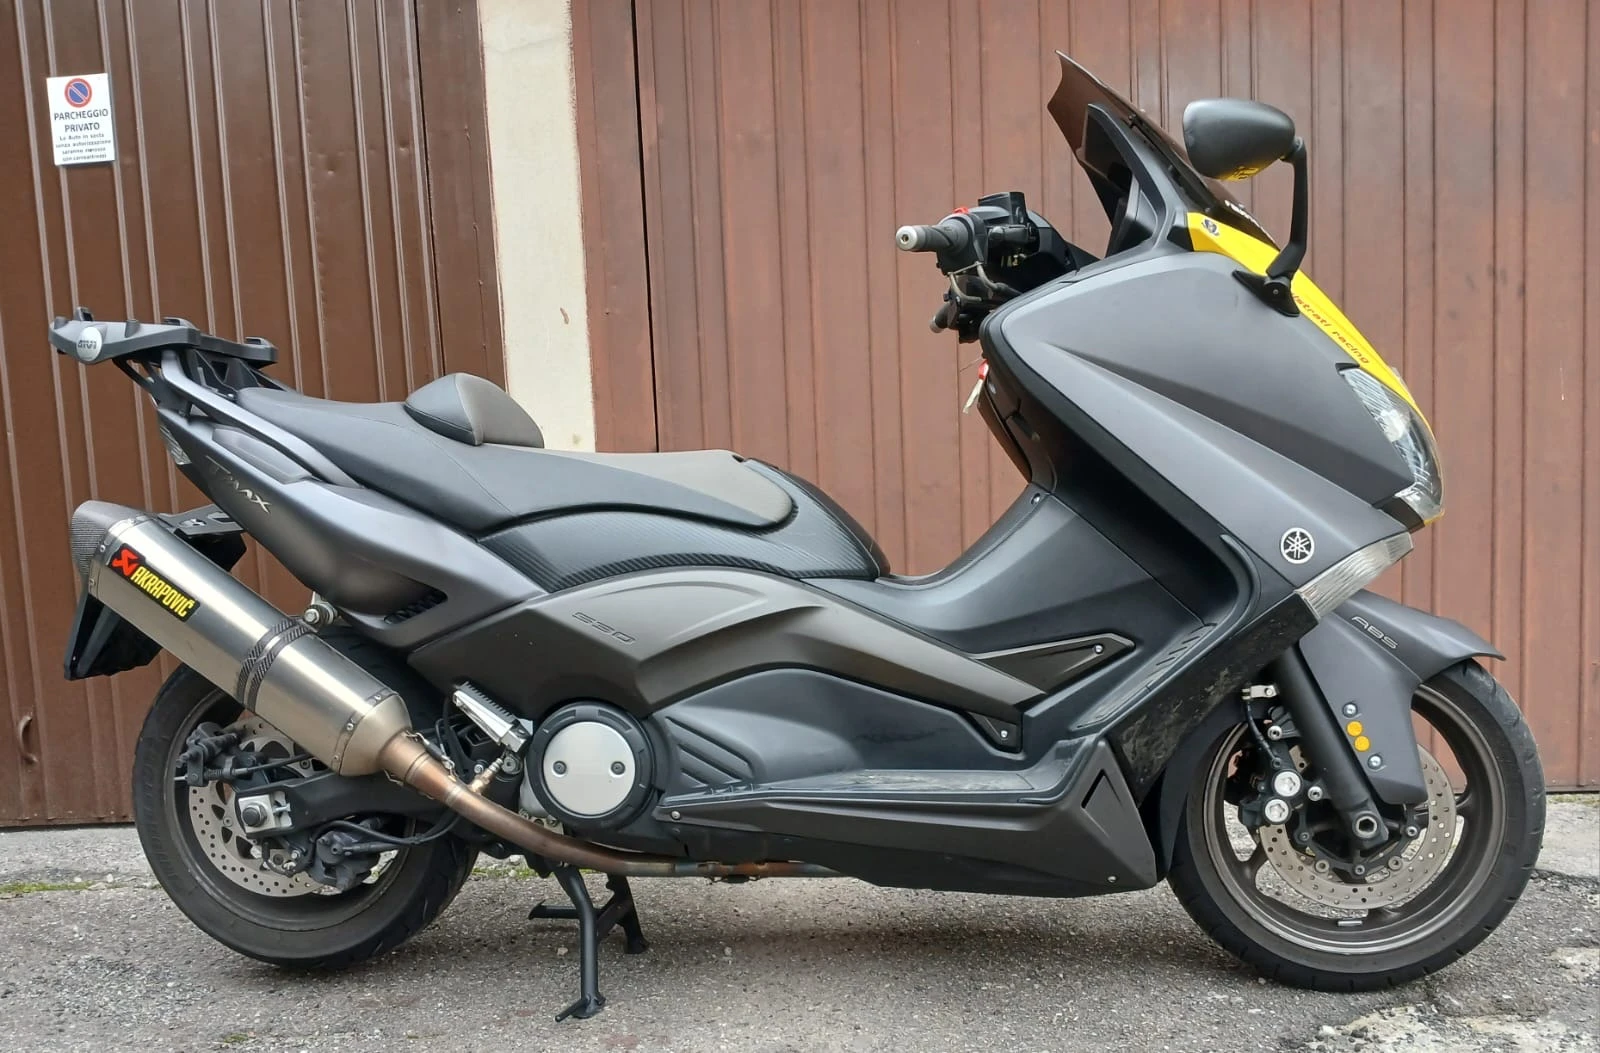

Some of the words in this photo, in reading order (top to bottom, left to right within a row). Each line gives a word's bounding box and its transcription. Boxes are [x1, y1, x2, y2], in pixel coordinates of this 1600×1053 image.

[54, 108, 108, 120] PARCHEGGIO
[64, 122, 100, 132] PRIVATO
[571, 611, 637, 643] 530
[1351, 616, 1399, 649] ABS
